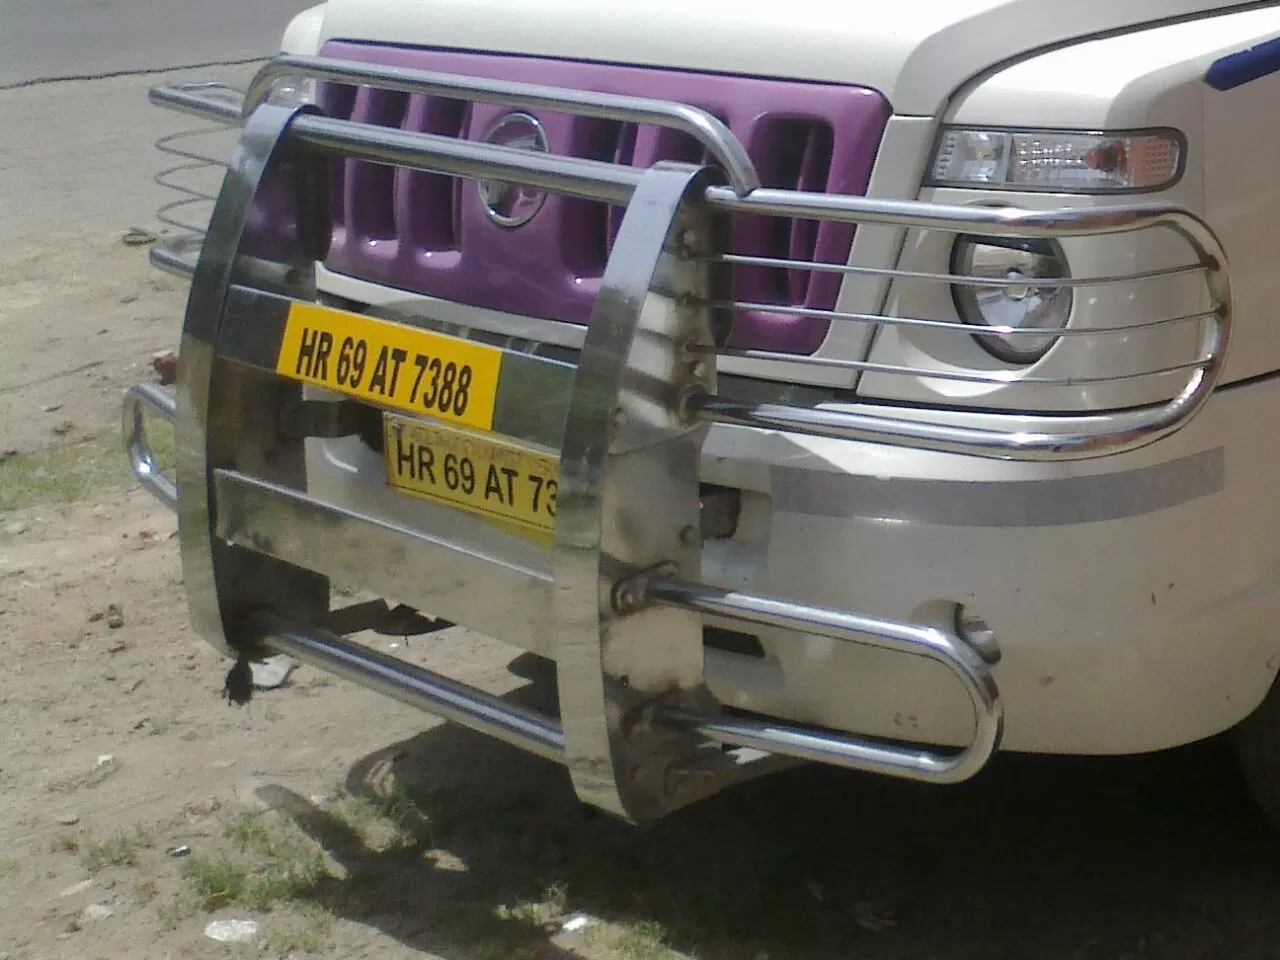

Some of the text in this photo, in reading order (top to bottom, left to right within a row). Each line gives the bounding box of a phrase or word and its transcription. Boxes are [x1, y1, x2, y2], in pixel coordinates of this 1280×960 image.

[296, 327, 472, 417] HR 69 AT 7388
[396, 436, 437, 485] HR
[443, 453, 475, 496] 69
[484, 463, 520, 507] AT
